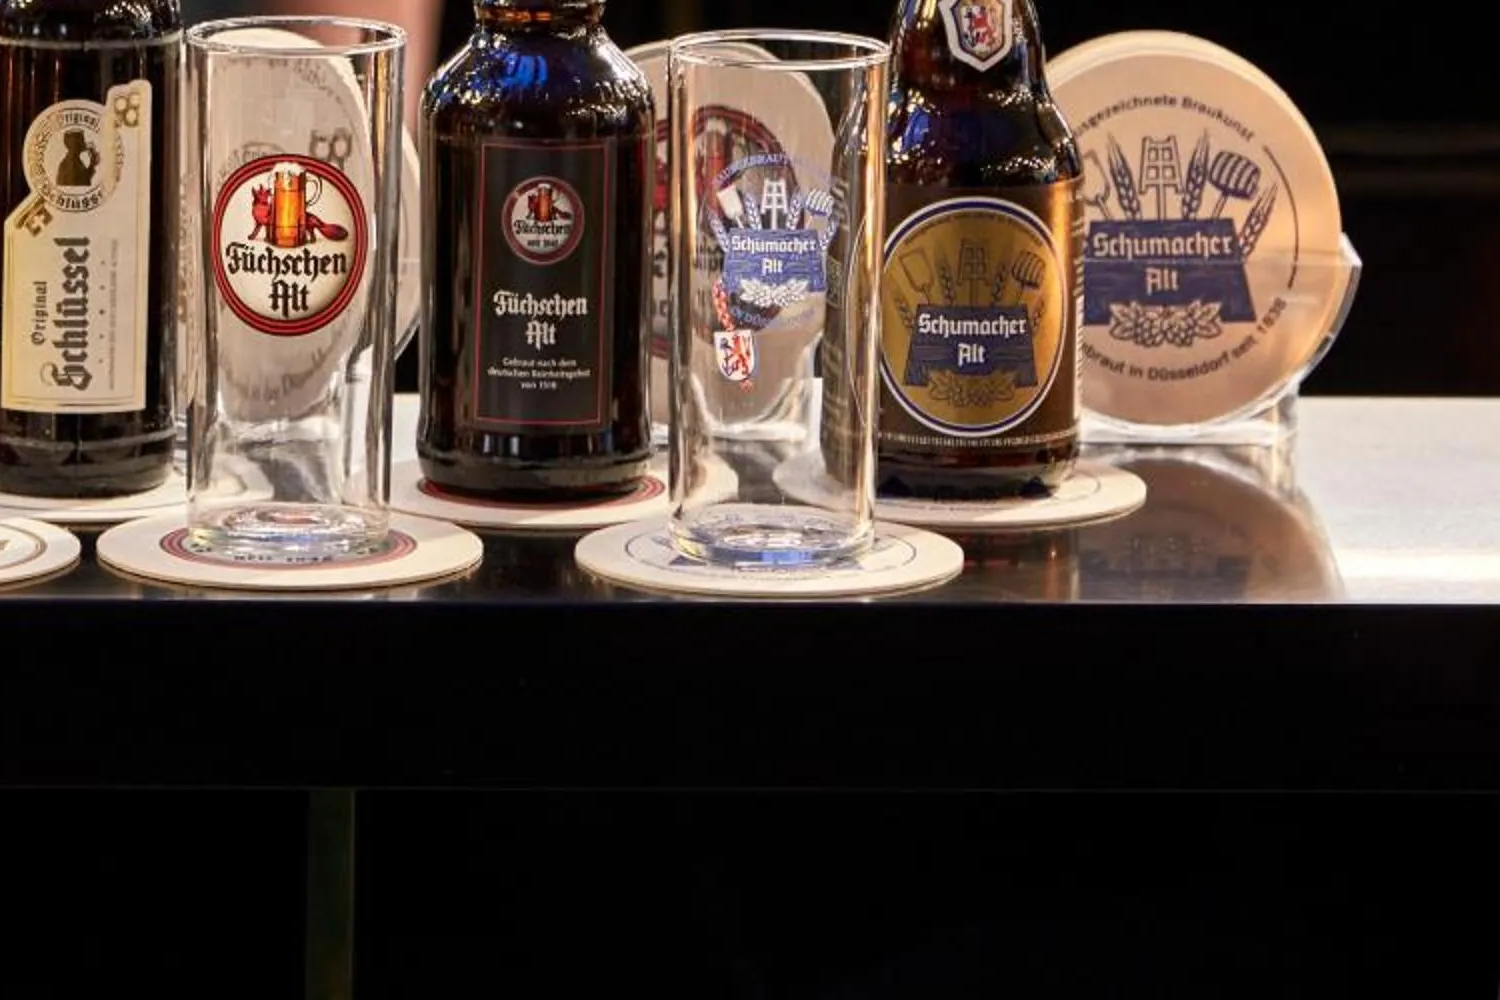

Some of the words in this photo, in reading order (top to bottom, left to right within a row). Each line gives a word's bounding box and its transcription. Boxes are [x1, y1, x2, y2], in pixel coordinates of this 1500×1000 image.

[1181, 96, 1255, 142] Braukunst
[730, 235, 818, 254] Schumacher
[1092, 231, 1233, 263] Schumacher
[225, 241, 349, 283] Füchschen
[760, 257, 784, 276] Alt
[1145, 267, 1179, 295] Alt
[30, 280, 49, 346] Original
[51, 236, 93, 391] Schlüssel
[269, 279, 310, 318] Alt
[492, 288, 588, 321] Füchschen
[524, 320, 557, 351] Alt
[917, 313, 1027, 338] Schumacher
[957, 343, 986, 367] Alt
[1129, 363, 1143, 379] in
[1147, 349, 1231, 382] Düsseldorf
